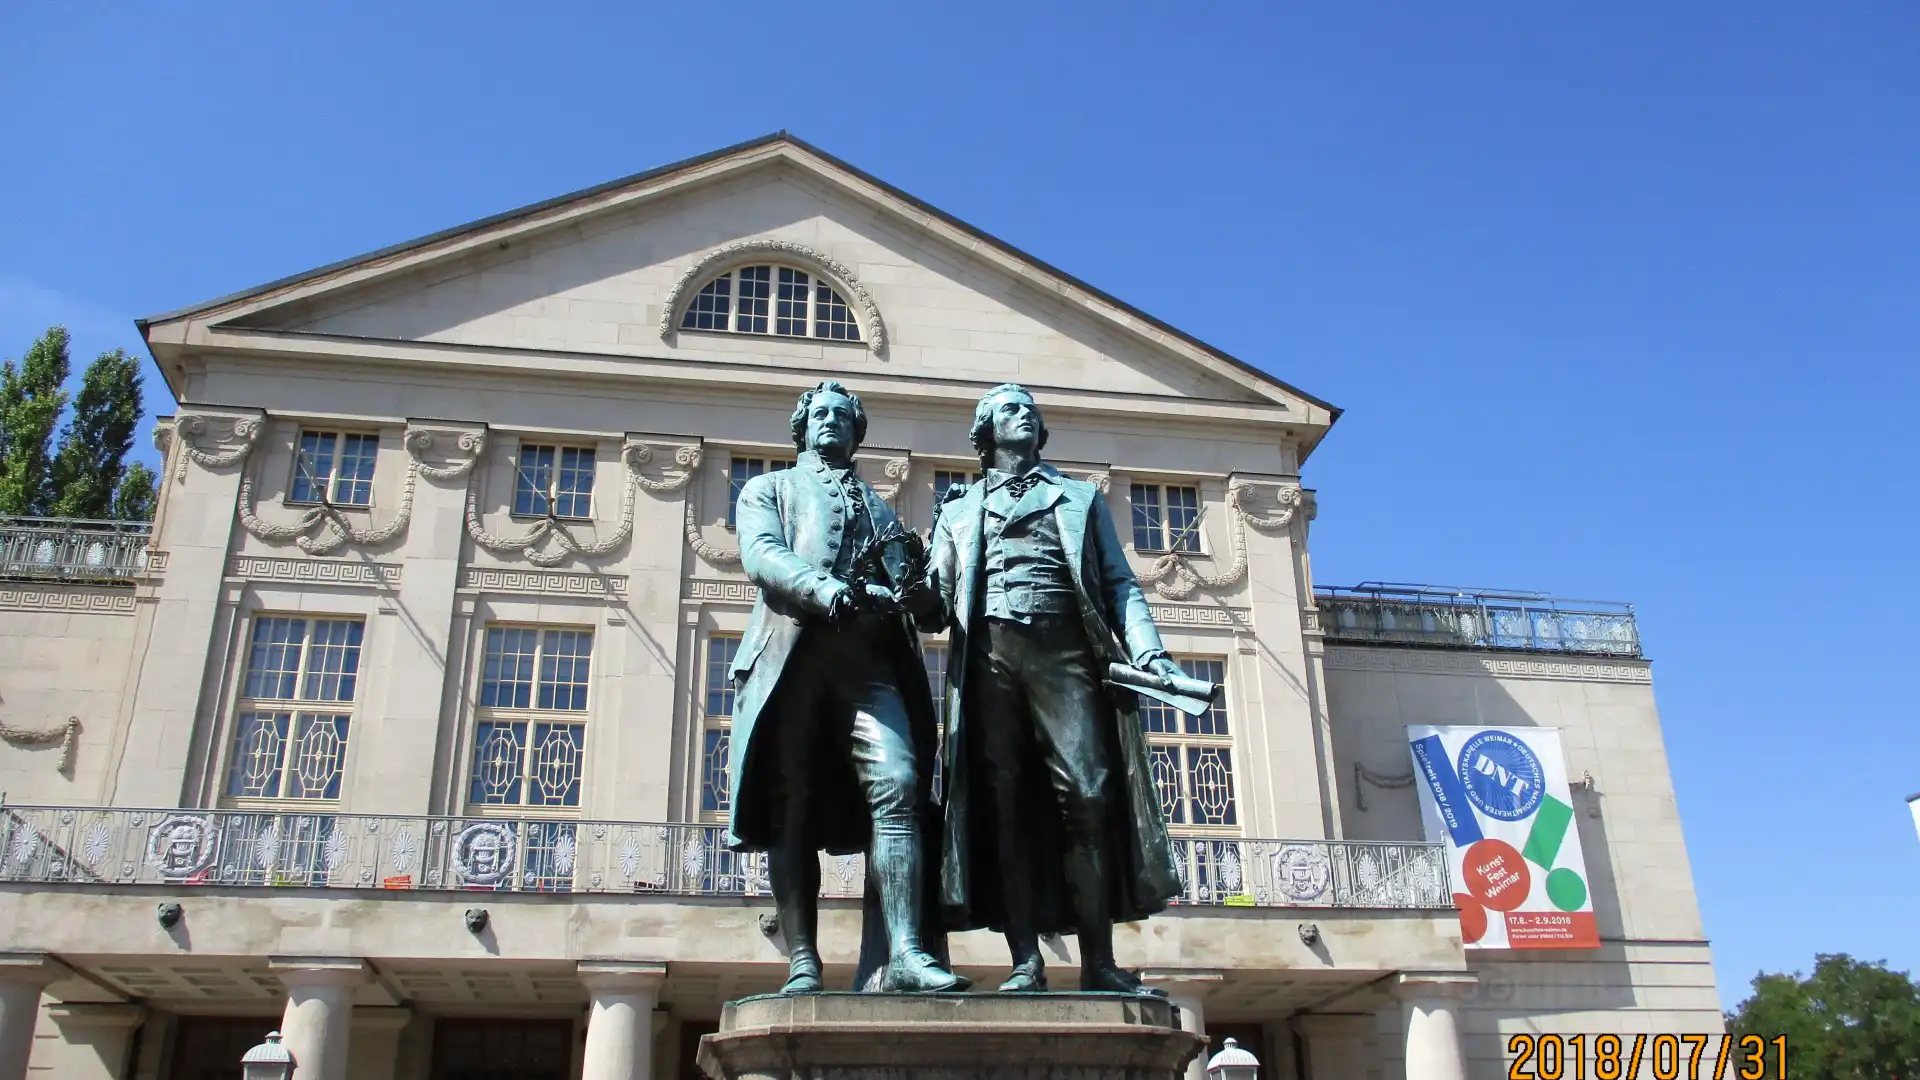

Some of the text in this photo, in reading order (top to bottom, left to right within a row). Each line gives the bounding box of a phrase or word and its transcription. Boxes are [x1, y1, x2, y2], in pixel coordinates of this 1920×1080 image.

[1483, 735, 1513, 745] WEIMAR
[1415, 743, 1437, 781] Spielzeit
[1462, 738, 1484, 790] STAATSKAPELLE
[1517, 746, 1541, 789] DEUTSCHES
[1472, 753, 1529, 797] DNT
[1470, 791, 1484, 806] UND
[1476, 854, 1505, 876] Kunst
[1486, 867, 1508, 884] Fest
[1484, 872, 1520, 898] Weimar
[1534, 916, 1571, 925] 2.9.2018
